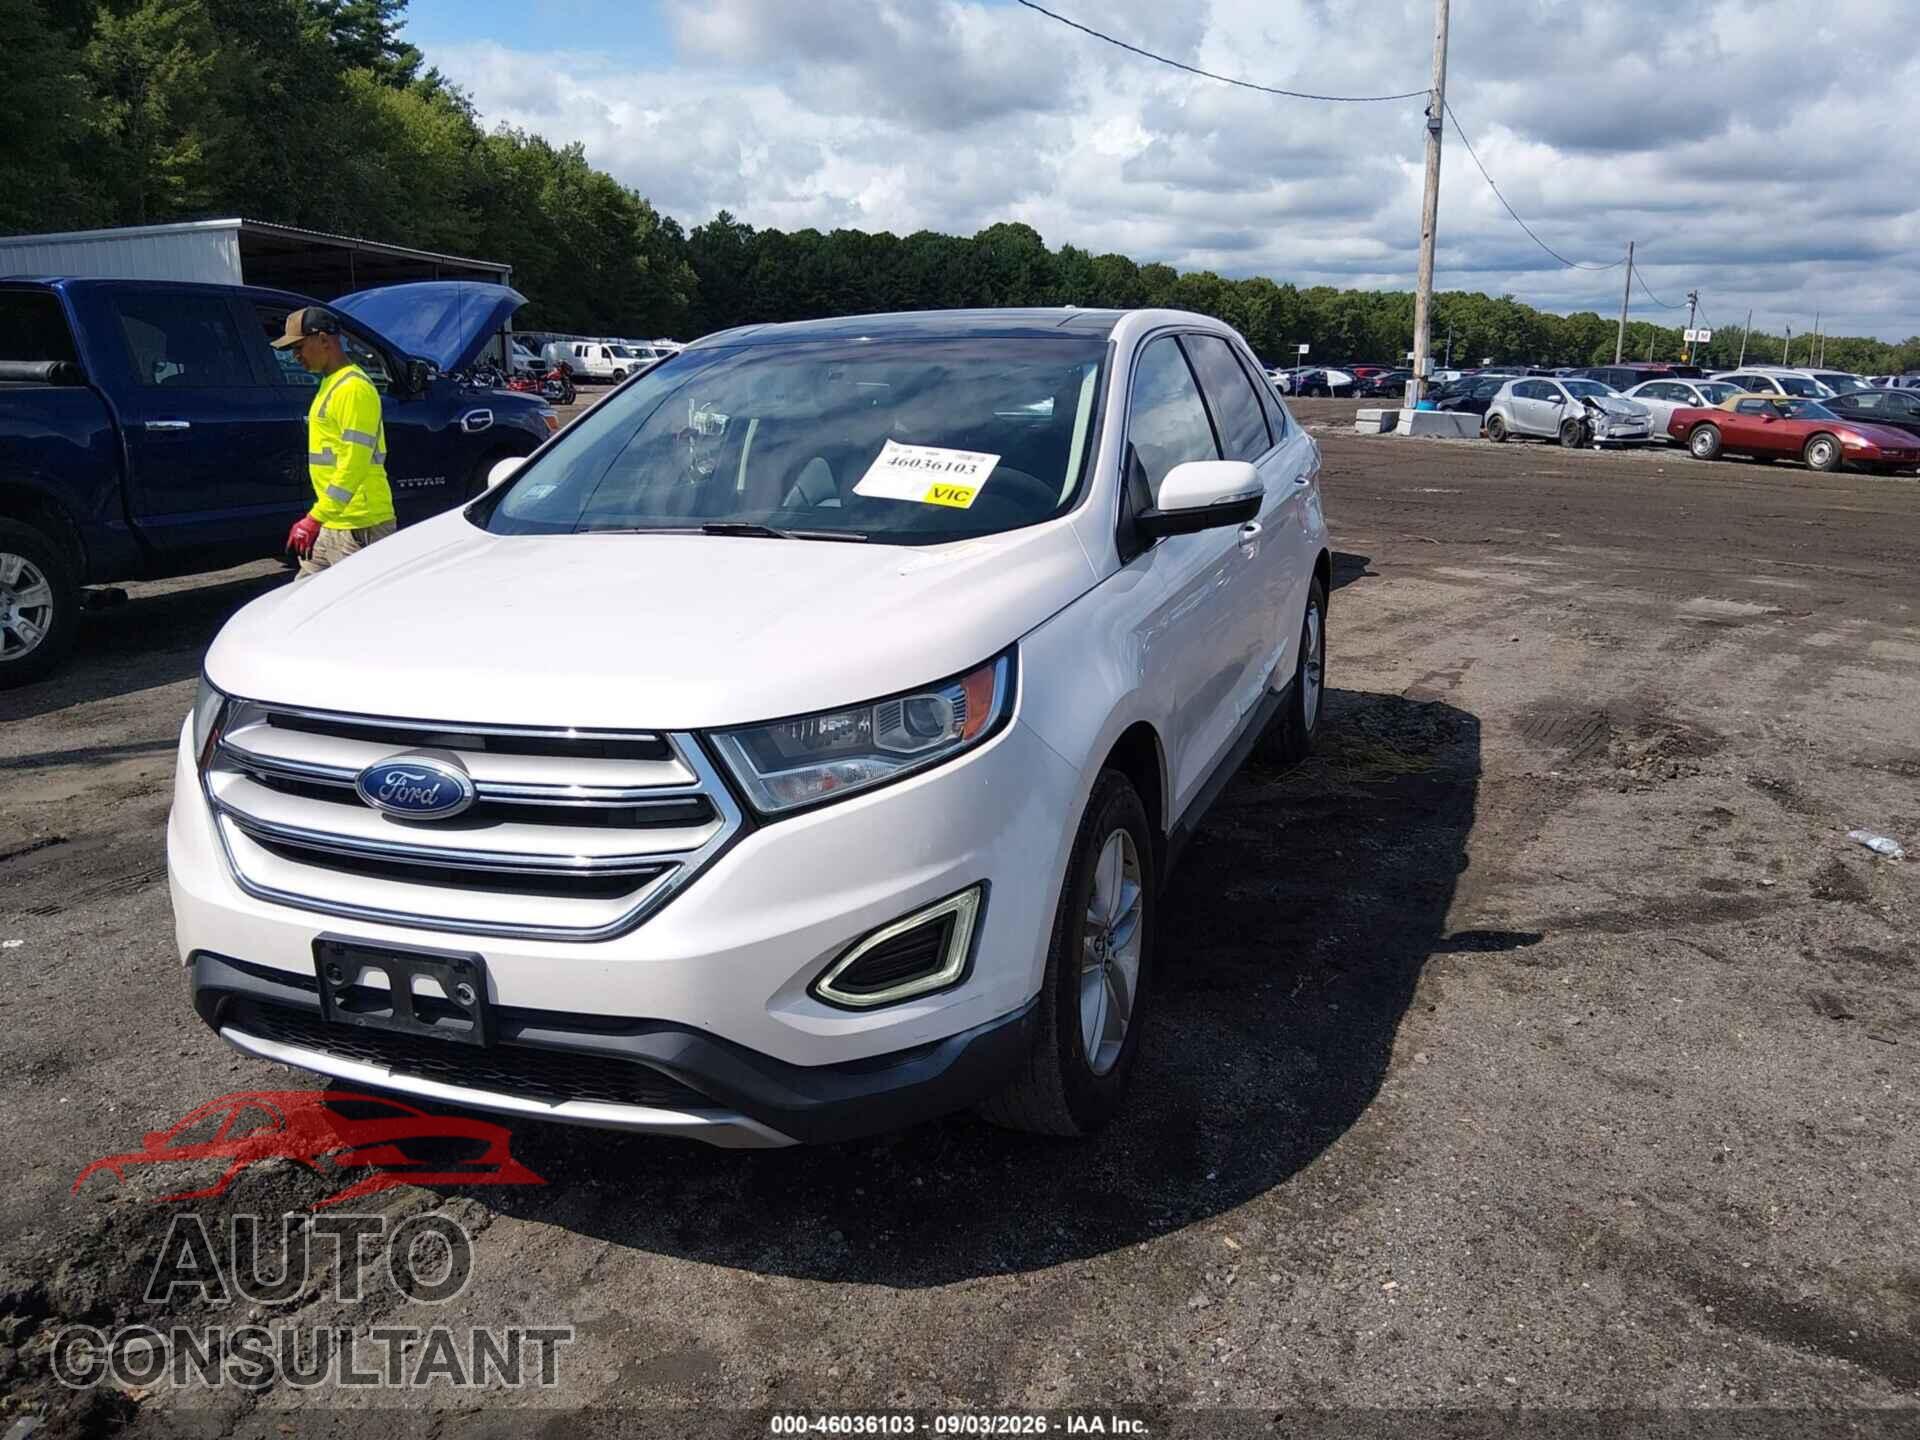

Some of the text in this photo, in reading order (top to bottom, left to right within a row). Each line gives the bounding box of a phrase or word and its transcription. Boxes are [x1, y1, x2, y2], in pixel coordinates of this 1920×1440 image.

[888, 456, 978, 475] 46036103
[397, 475, 446, 488] TITAN
[933, 487, 970, 503] VIC
[379, 770, 441, 805] Ford
